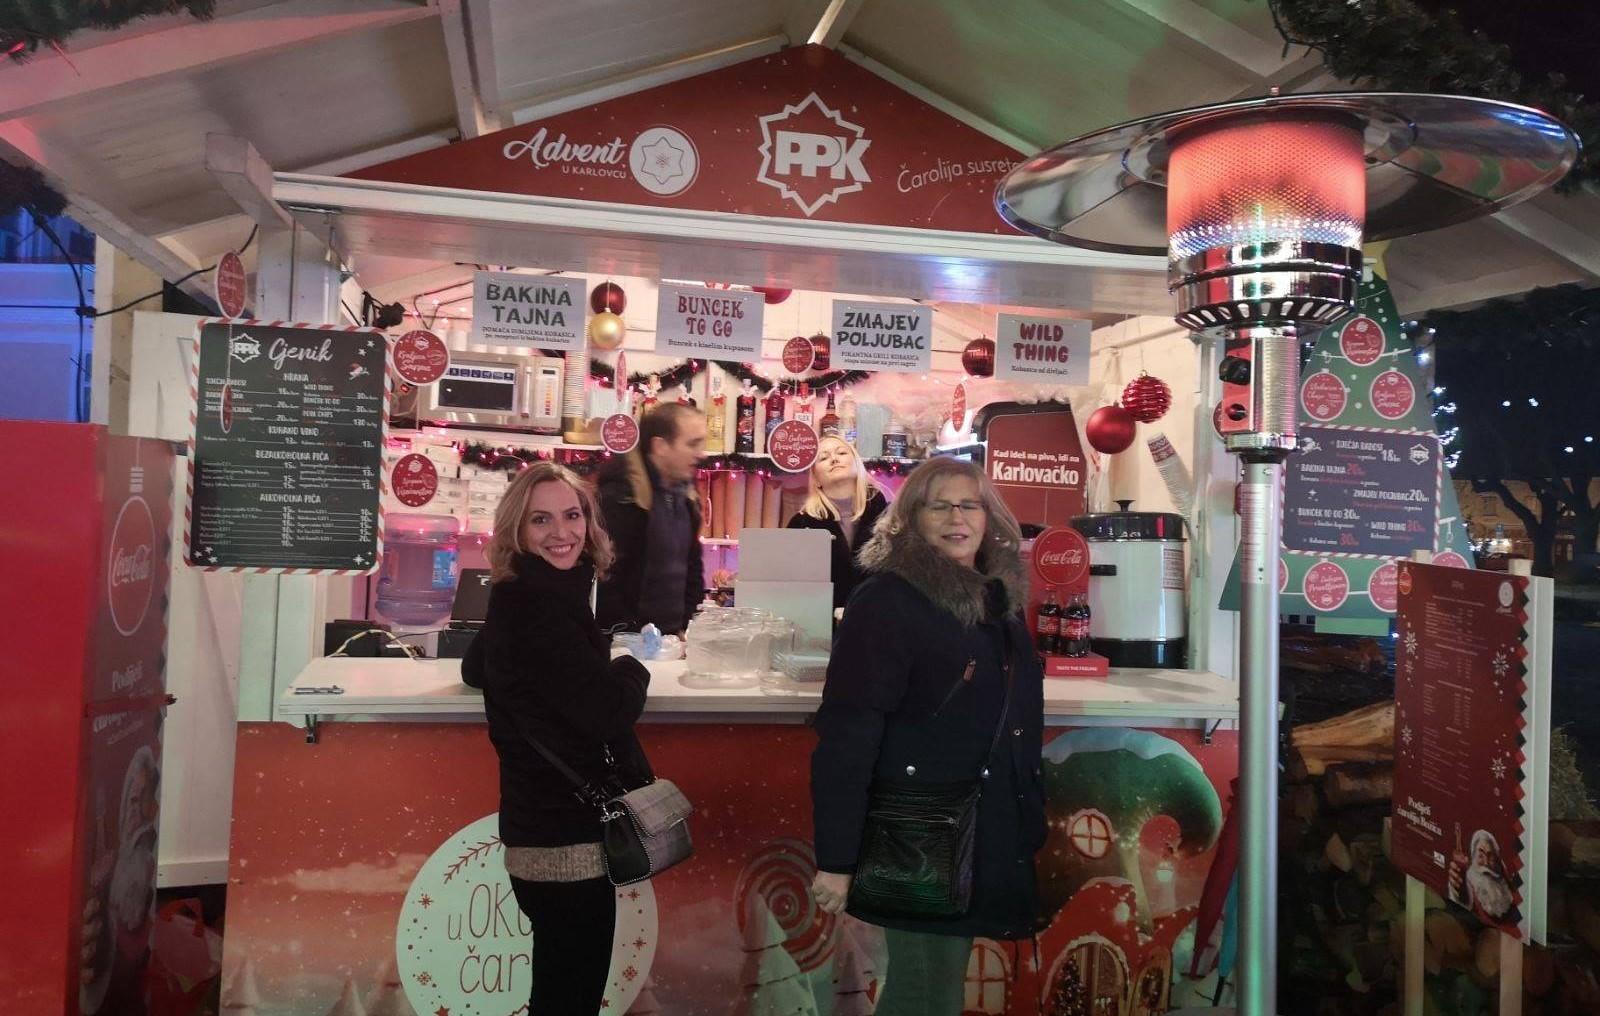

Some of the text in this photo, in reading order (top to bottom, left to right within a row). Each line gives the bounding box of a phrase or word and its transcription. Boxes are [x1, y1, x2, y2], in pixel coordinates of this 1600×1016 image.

[503, 127, 627, 169] Advent
[774, 130, 872, 183] PPK
[562, 166, 626, 179] U KARLOVCU
[897, 158, 963, 193] Čarolija
[486, 282, 572, 306] BAKINA
[492, 305, 565, 327] TAJNA
[678, 295, 744, 319] BUNCEK
[686, 317, 733, 338] TO GO
[842, 312, 920, 331] ZMAJEV
[837, 331, 925, 350] POLJUBAC
[1020, 323, 1064, 342] WILD
[698, 341, 723, 350] kiselim
[723, 343, 755, 353] kupusom
[1013, 342, 1070, 363] THING
[255, 450, 311, 461] BEZALKOHOLNA
[993, 449, 1080, 463] Kad ideš na pivo, idi na
[992, 460, 1079, 485] Karlovačko
[260, 493, 303, 503] ALKOHOLNA
[112, 544, 151, 586] Coca-Cola
[1040, 549, 1082, 567] Coca-Cola
